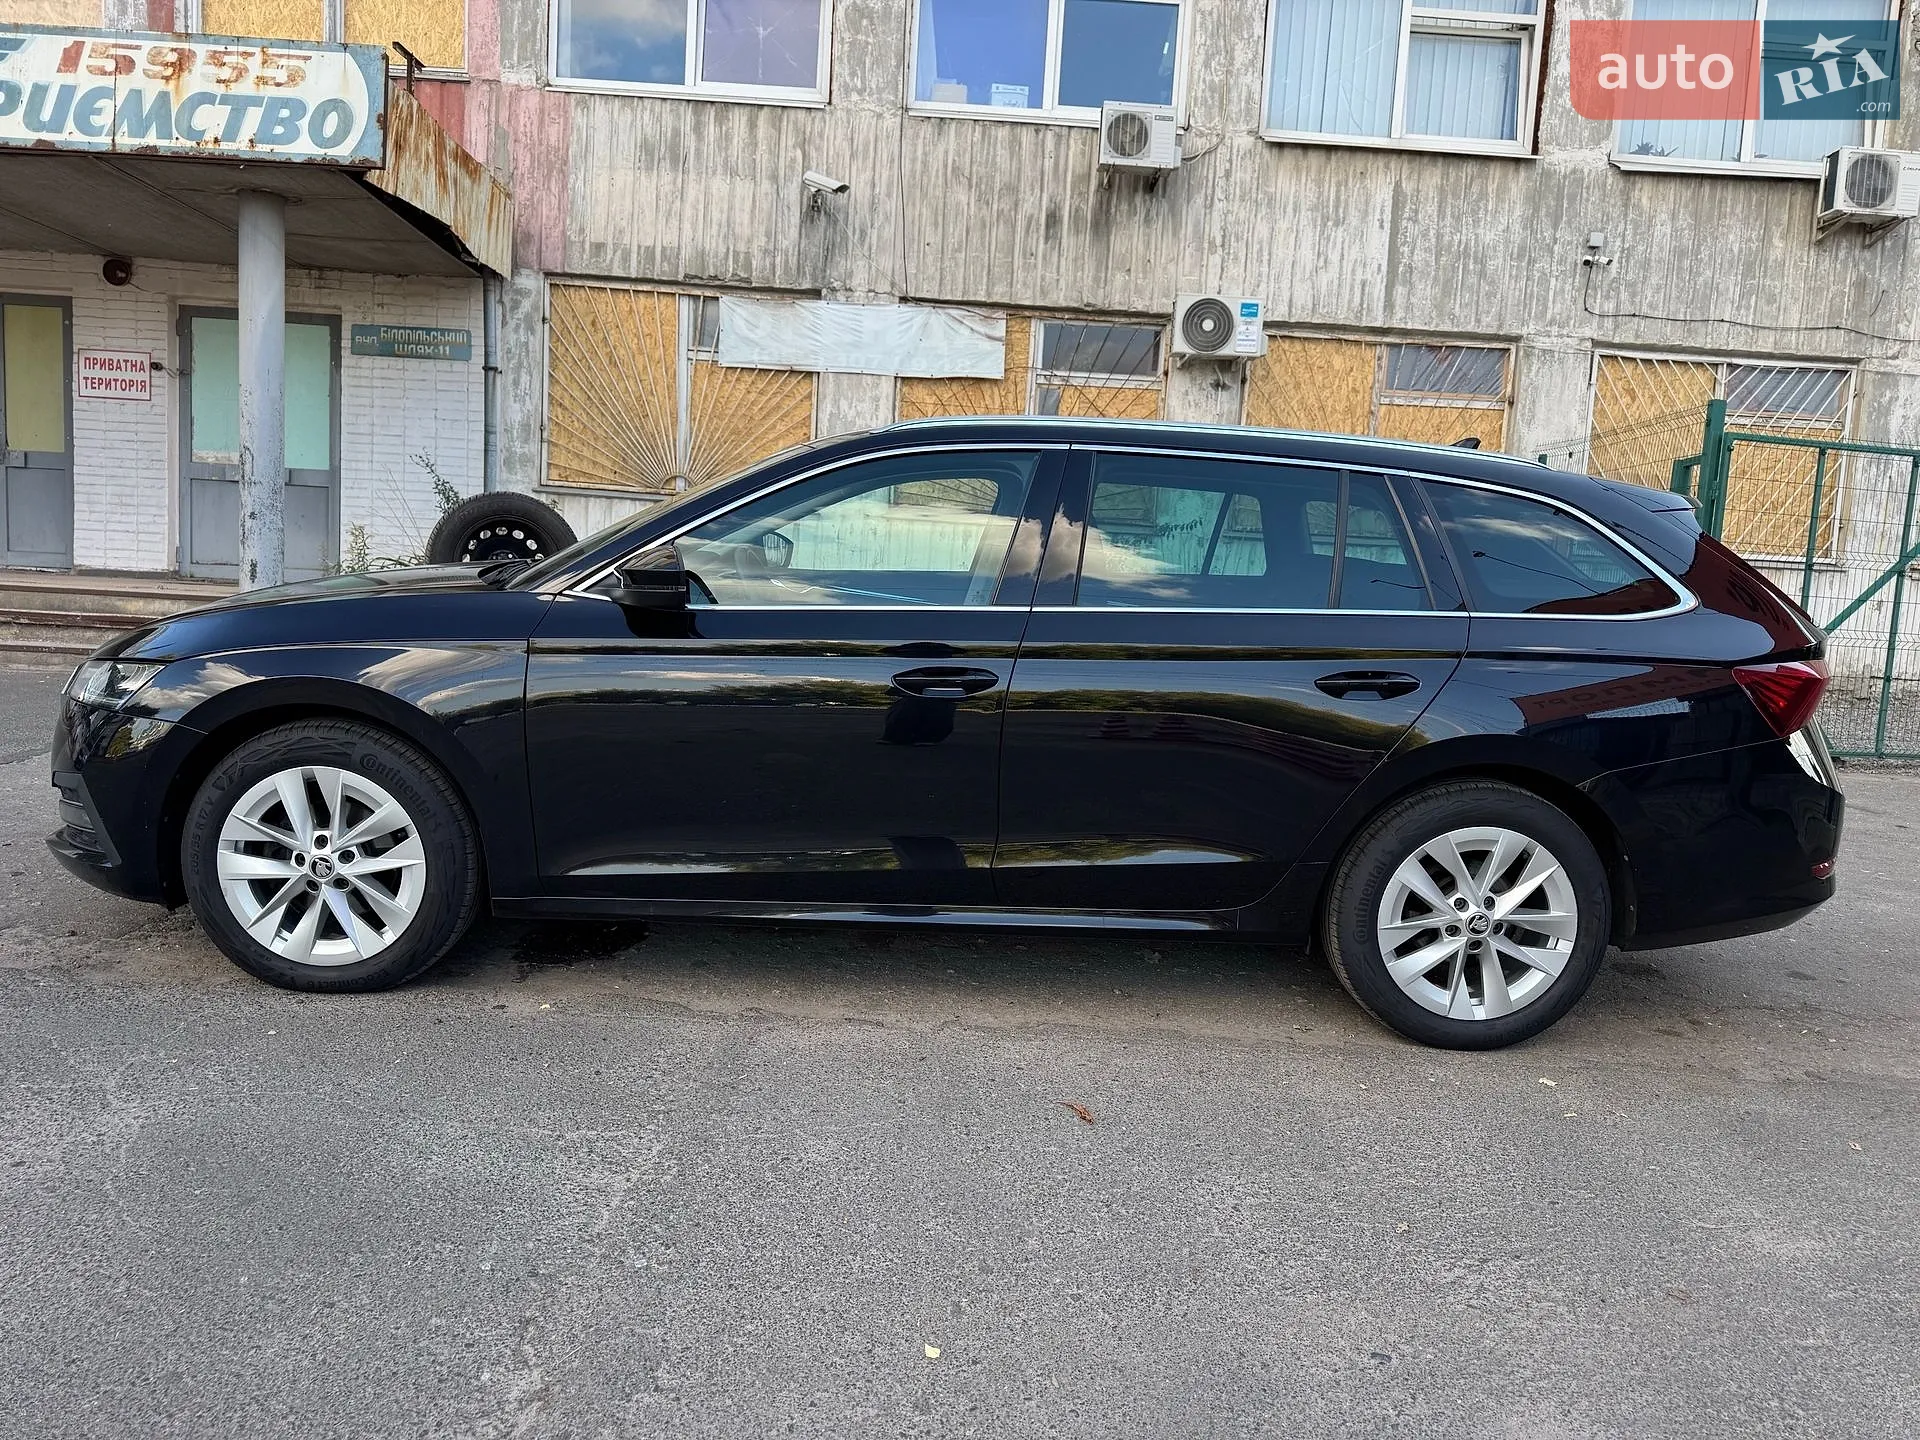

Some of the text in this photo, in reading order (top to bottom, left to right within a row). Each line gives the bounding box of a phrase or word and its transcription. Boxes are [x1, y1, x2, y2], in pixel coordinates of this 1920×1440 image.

[56, 40, 313, 88] 15955
[83, 376, 147, 393] ТЕРИТОРІЯ
[84, 356, 146, 373] ПРИВАТНА
[360, 753, 437, 820] Continental
[1353, 857, 1389, 945] Continental
